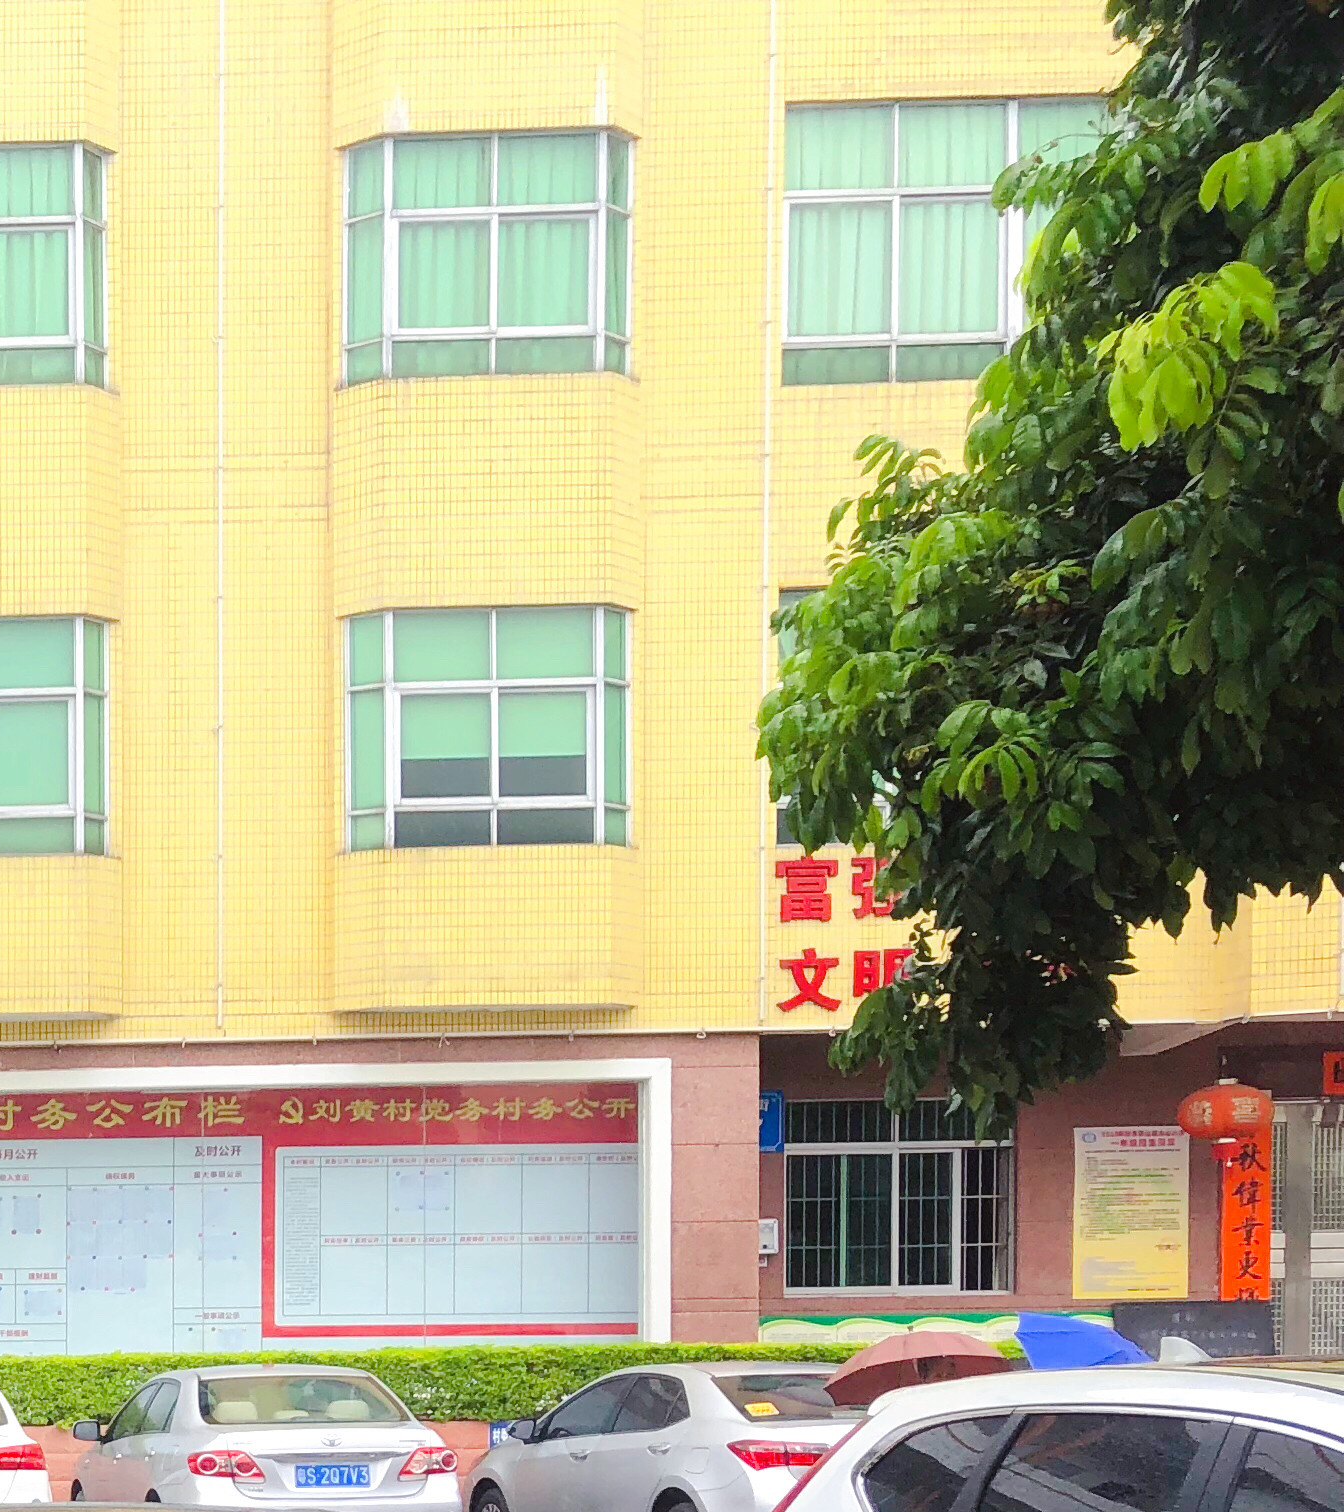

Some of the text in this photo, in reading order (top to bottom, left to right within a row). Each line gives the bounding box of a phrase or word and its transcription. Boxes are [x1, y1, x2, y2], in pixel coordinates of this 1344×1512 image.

[776, 948, 916, 1012] 文明
[308, 1097, 636, 1124] 刘黄村党务村务公开
[194, 1145, 243, 1157] 及时公开
